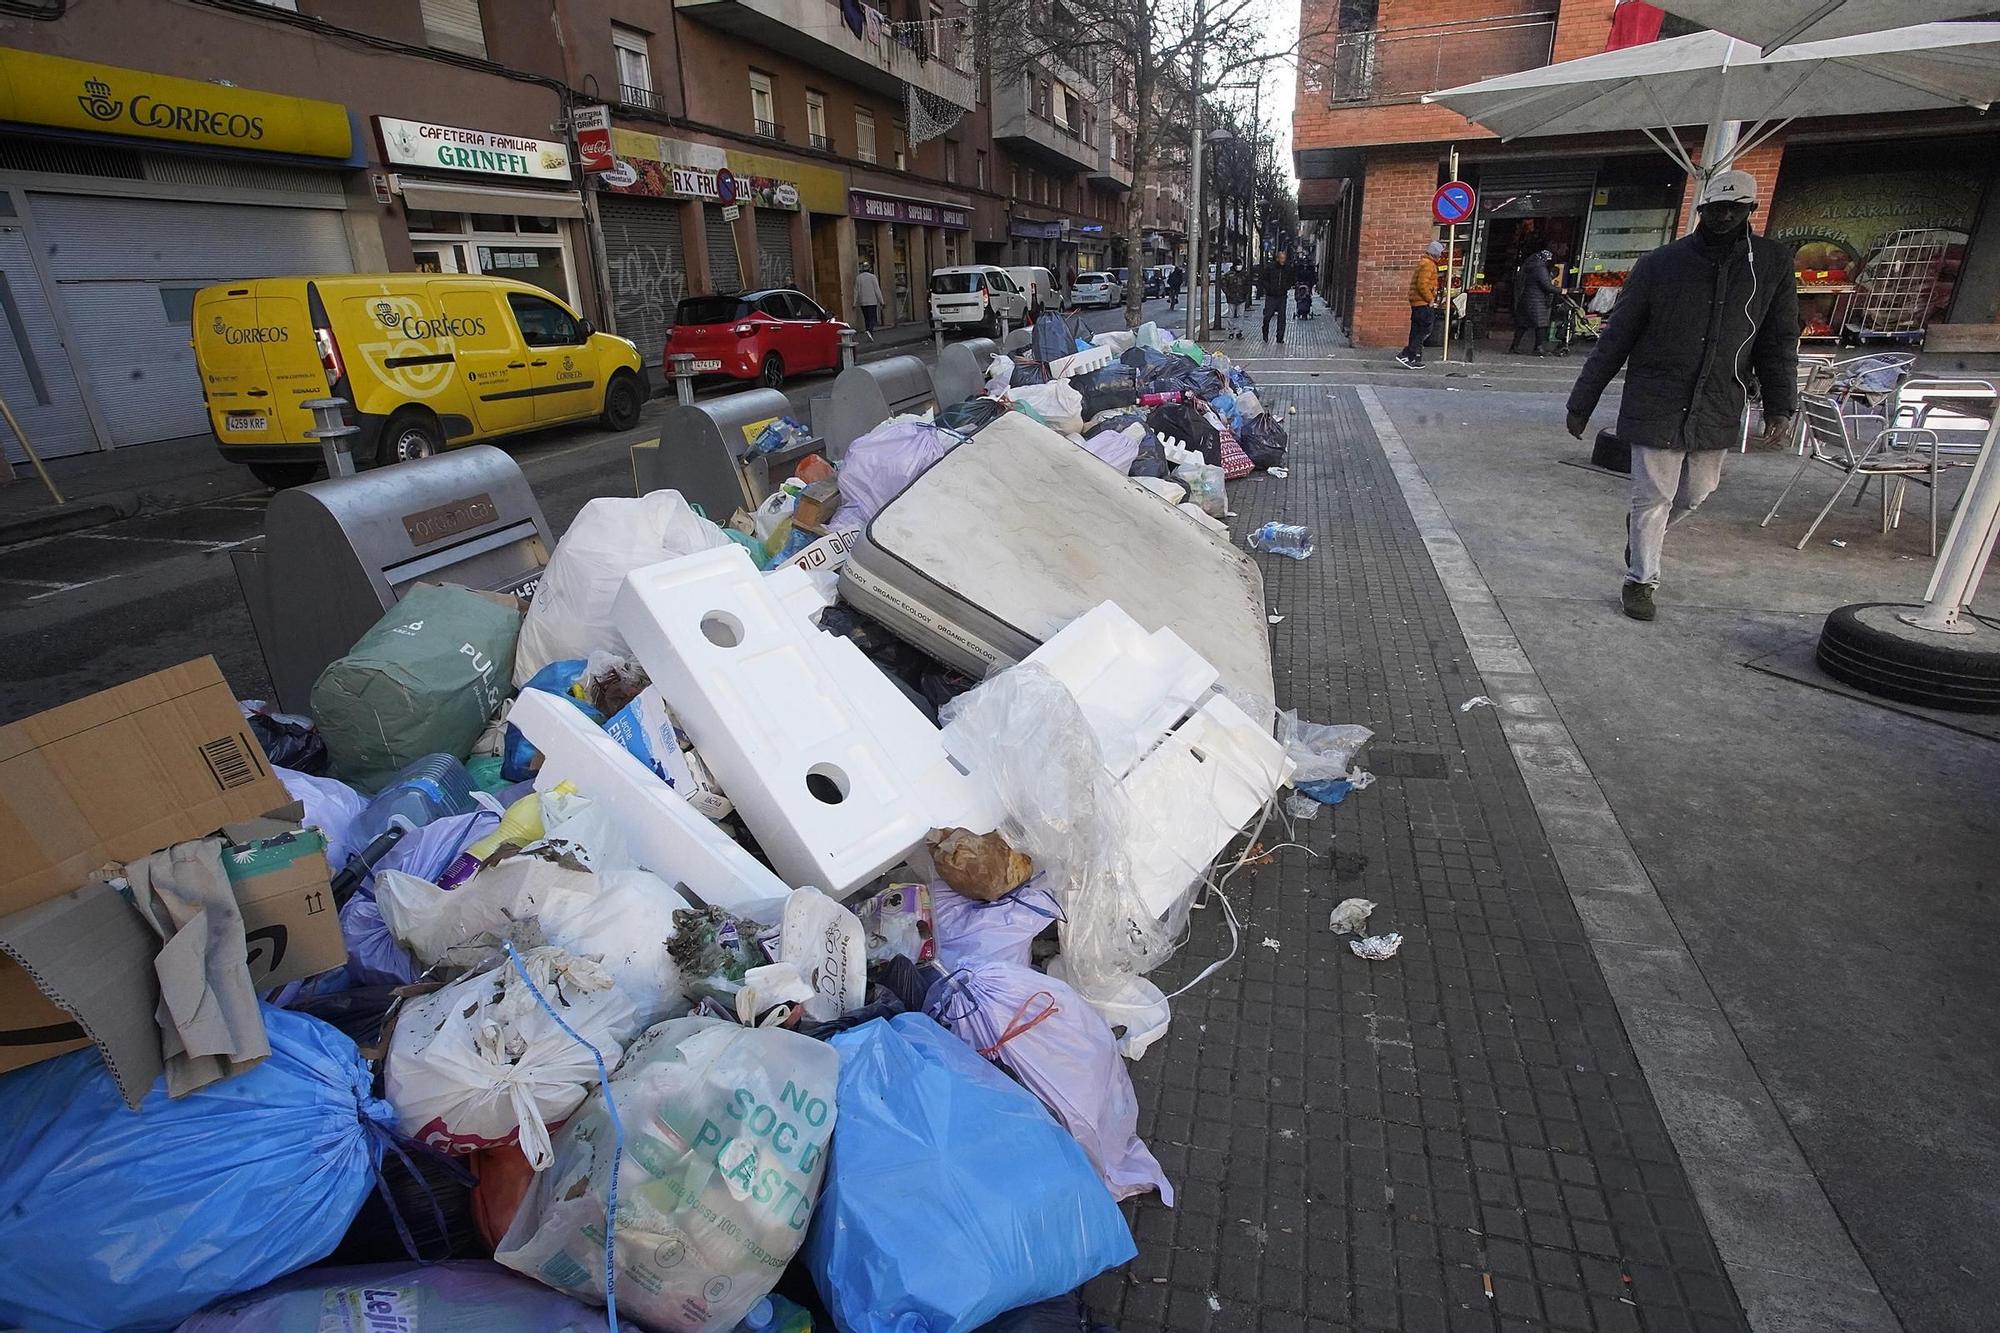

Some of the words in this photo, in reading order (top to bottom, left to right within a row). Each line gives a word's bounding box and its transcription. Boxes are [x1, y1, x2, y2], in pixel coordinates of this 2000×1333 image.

[129, 95, 264, 140] CORREOS
[575, 110, 602, 120] CAFETERIA
[577, 118, 603, 129] GRINFFI
[419, 126, 485, 146] CAFETERIA
[490, 136, 538, 153] FAMILIAR
[437, 145, 529, 174] GRINFFI
[1721, 184, 1735, 192] LA
[865, 199, 883, 216] SUPER
[908, 205, 923, 220] SUPER
[943, 211, 956, 224] SUPER
[1820, 207, 1841, 219] AL
[1845, 202, 1923, 218] KARAMA
[1777, 224, 1849, 244] FRUITERIA
[225, 326, 289, 345] CORREOS
[230, 418, 249, 429] 4259
[250, 418, 265, 428] KRF
[872, 585, 901, 606] ORGANIC
[901, 602, 932, 624] ECOLOGY
[937, 624, 966, 645] ORGANIC
[966, 641, 997, 662] ECOLOGY
[619, 715, 633, 740] Leche
[779, 1080, 828, 1127] NO
[726, 1088, 799, 1154] SOC
[606, 1248, 617, 1295] NOLLENS
